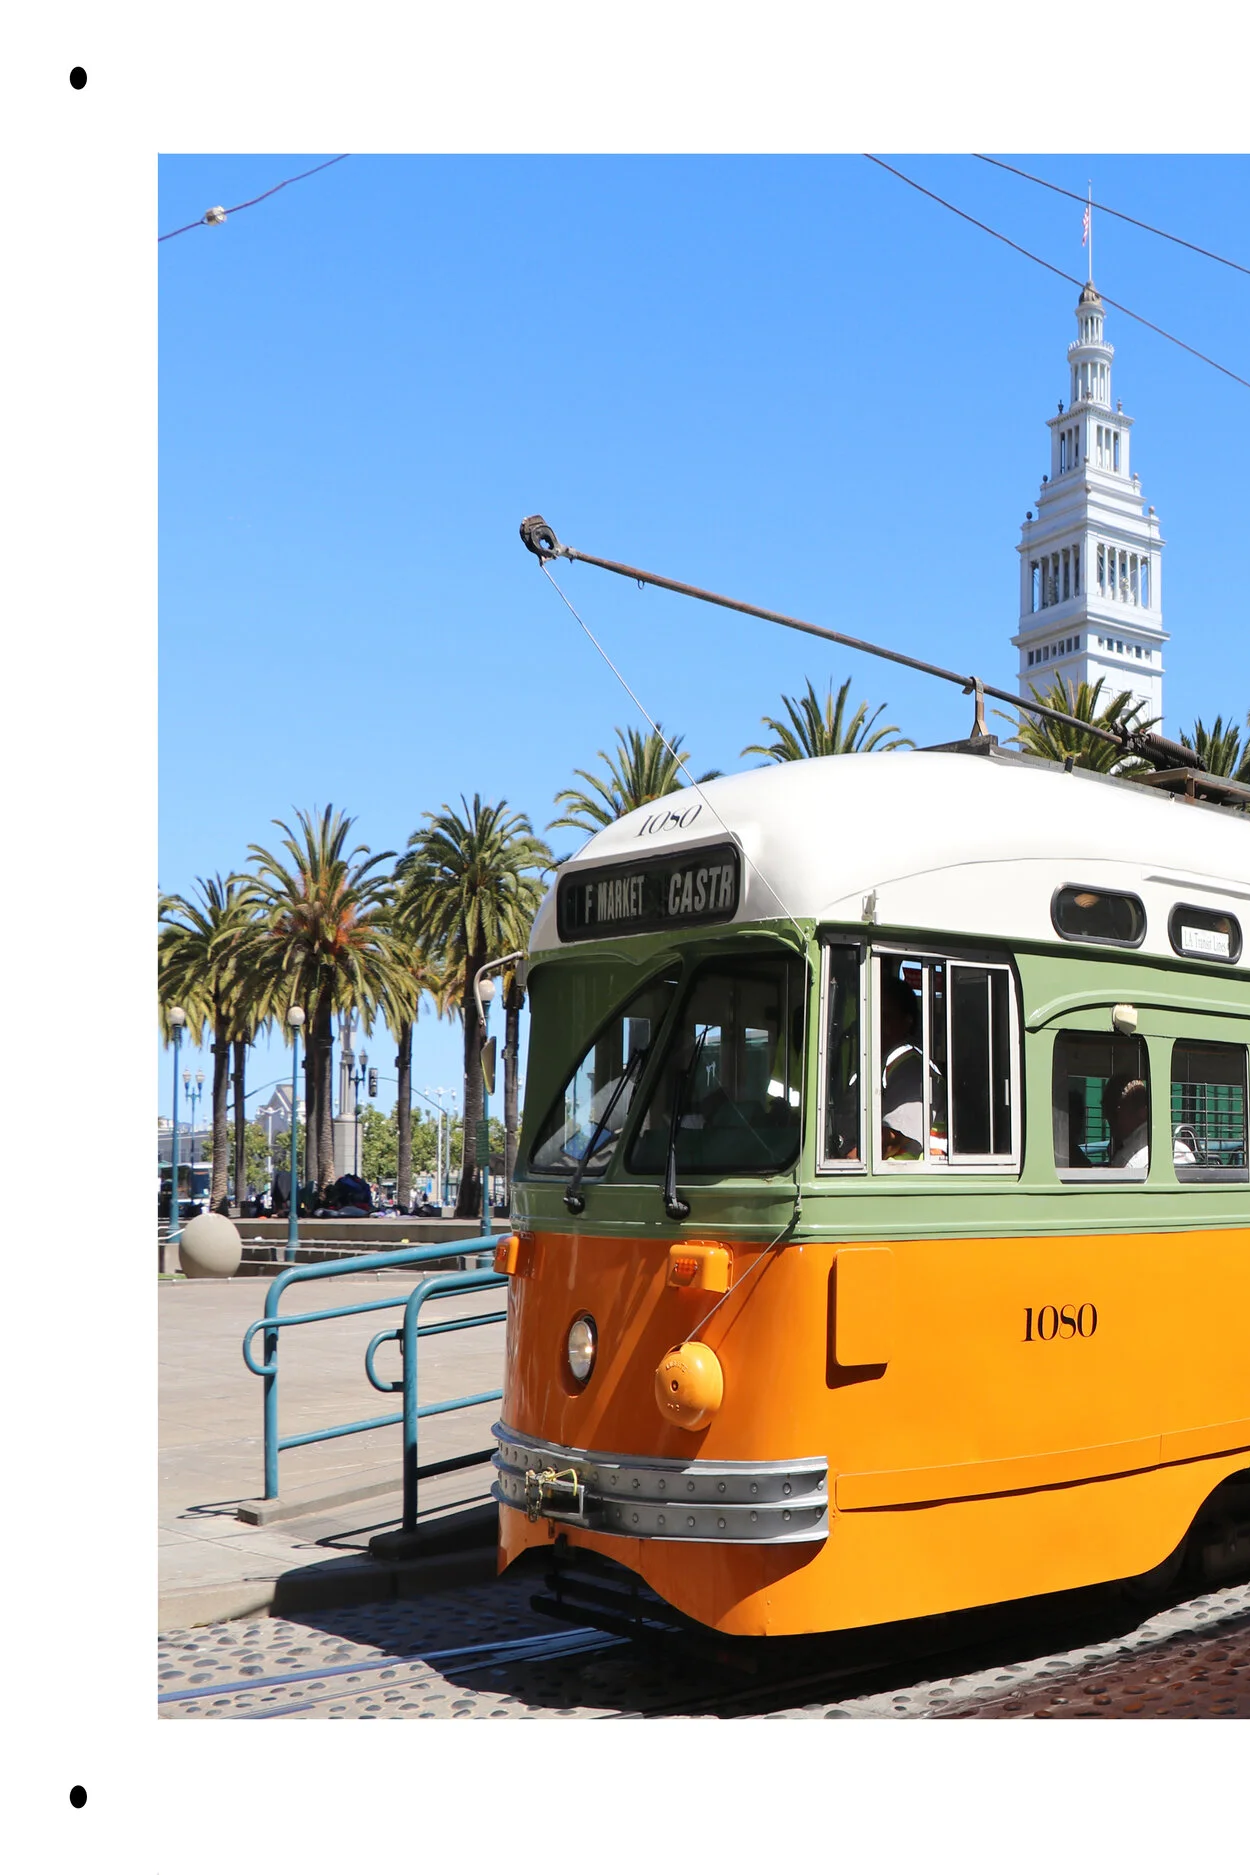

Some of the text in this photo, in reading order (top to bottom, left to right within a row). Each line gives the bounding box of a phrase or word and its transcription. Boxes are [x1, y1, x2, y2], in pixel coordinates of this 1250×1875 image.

[635, 804, 702, 838] 1080
[585, 865, 735, 924] F MARKET CASTR
[1021, 1303, 1098, 1342] 1080
